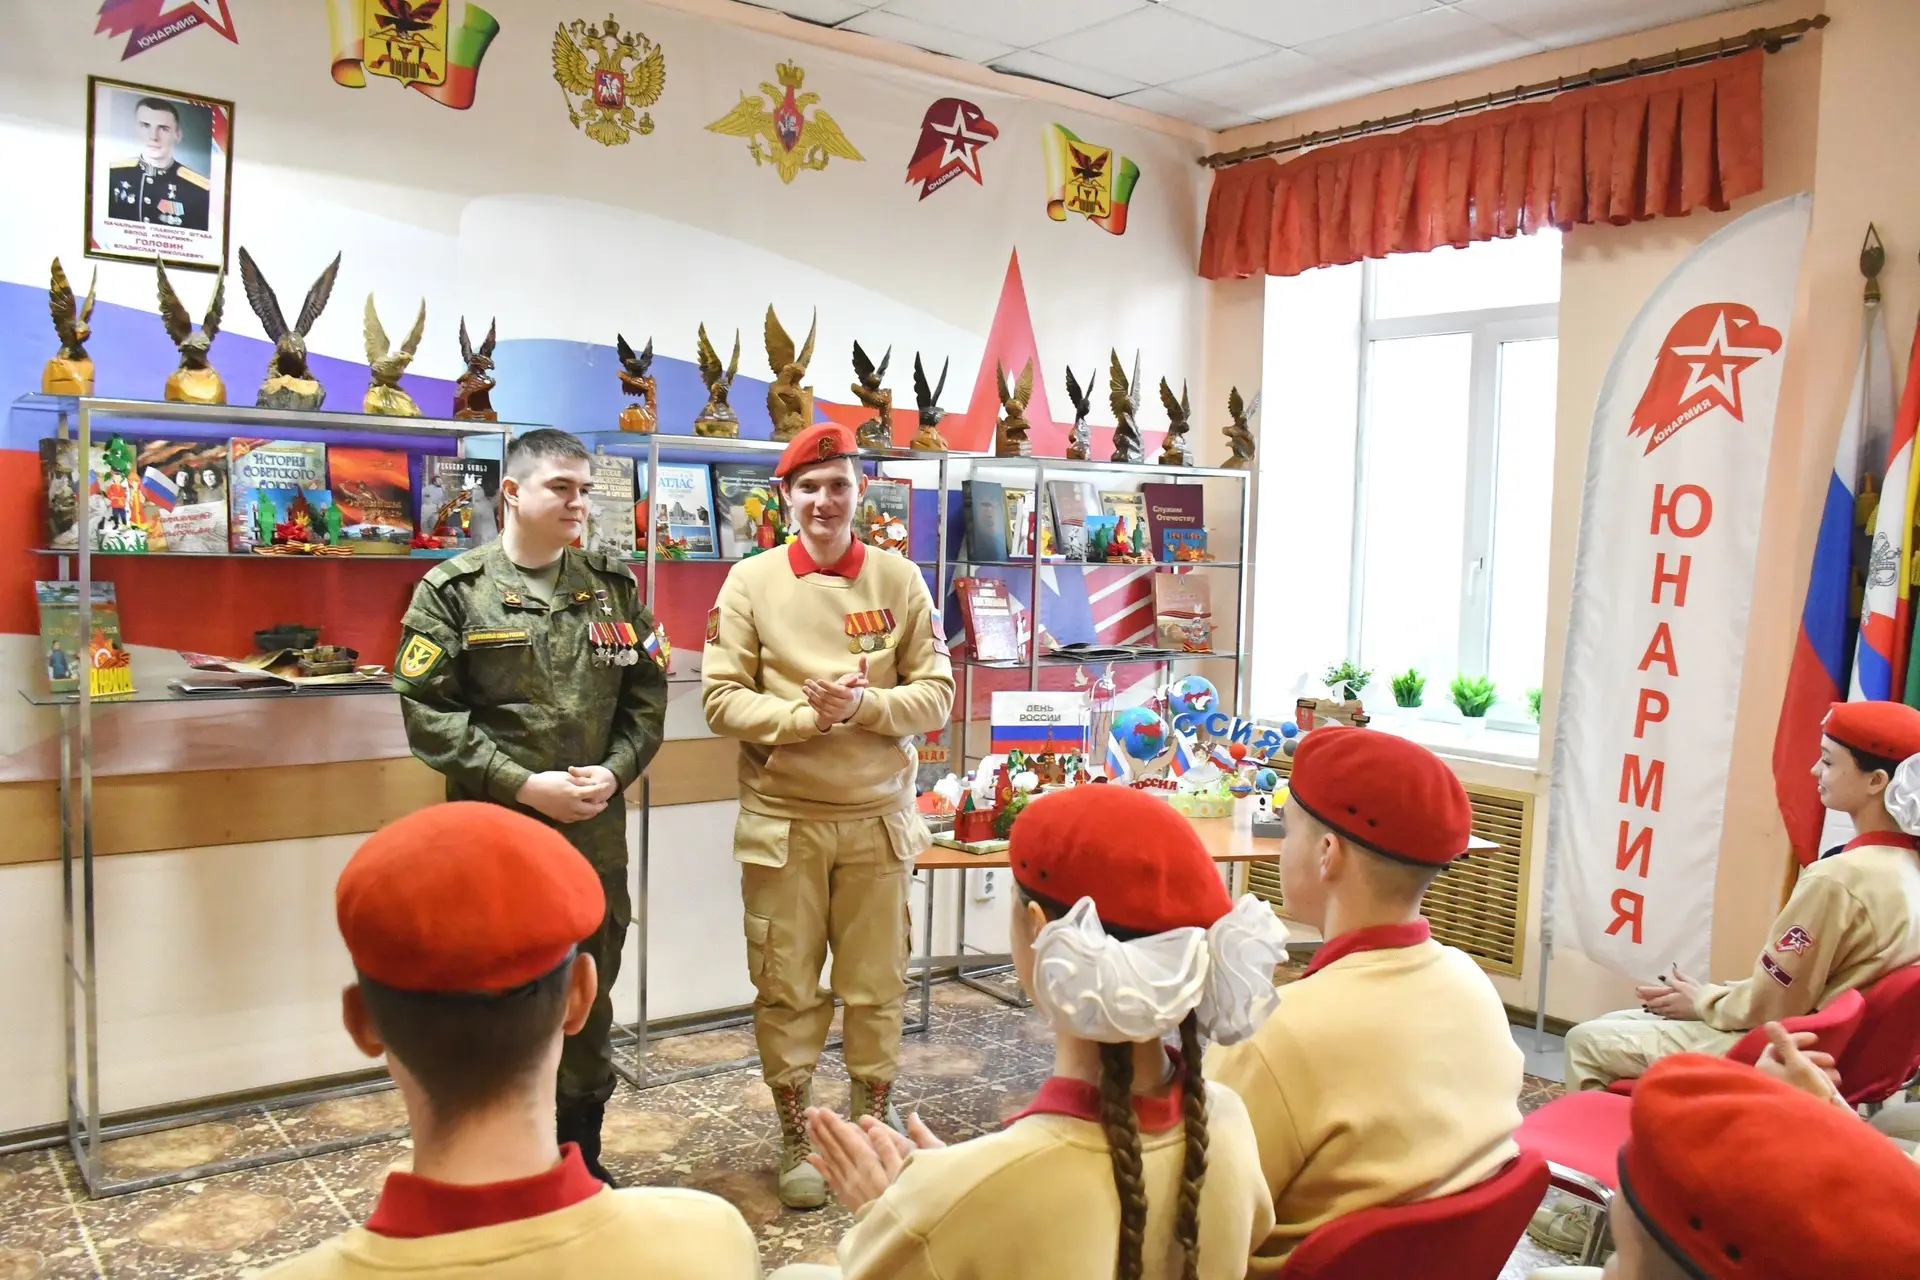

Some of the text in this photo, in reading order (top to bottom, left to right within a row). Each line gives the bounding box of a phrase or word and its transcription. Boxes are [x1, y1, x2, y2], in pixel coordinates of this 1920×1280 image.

[137, 15, 197, 48] ЮНАРМИЯ
[928, 166, 961, 191] ЮНАРМИЯ
[104, 220, 146, 230] НАЧАЛЬНИК
[150, 226, 185, 235] ГЛАВНОГО
[114, 243, 204, 259] ВЛАДИСЛАВ НИКОЛАЕВИЧ
[135, 238, 184, 250] ГОЛОВИН
[1653, 398, 1712, 444] ЮНАРМИЯ
[253, 452, 306, 467] ИСТОРИЯ
[243, 465, 316, 480] СОВЕТСКОГО
[658, 477, 695, 489] АТЛАС
[1152, 505, 1183, 514] Служим
[1156, 514, 1196, 524] Отечеству
[1026, 704, 1054, 712] ДЕНЬ
[1604, 483, 1713, 944] ЮНАРМИЯ
[1019, 713, 1061, 722] РОССИИ
[1174, 712, 1281, 758] ССИЯ
[918, 750, 945, 761] БЕДА
